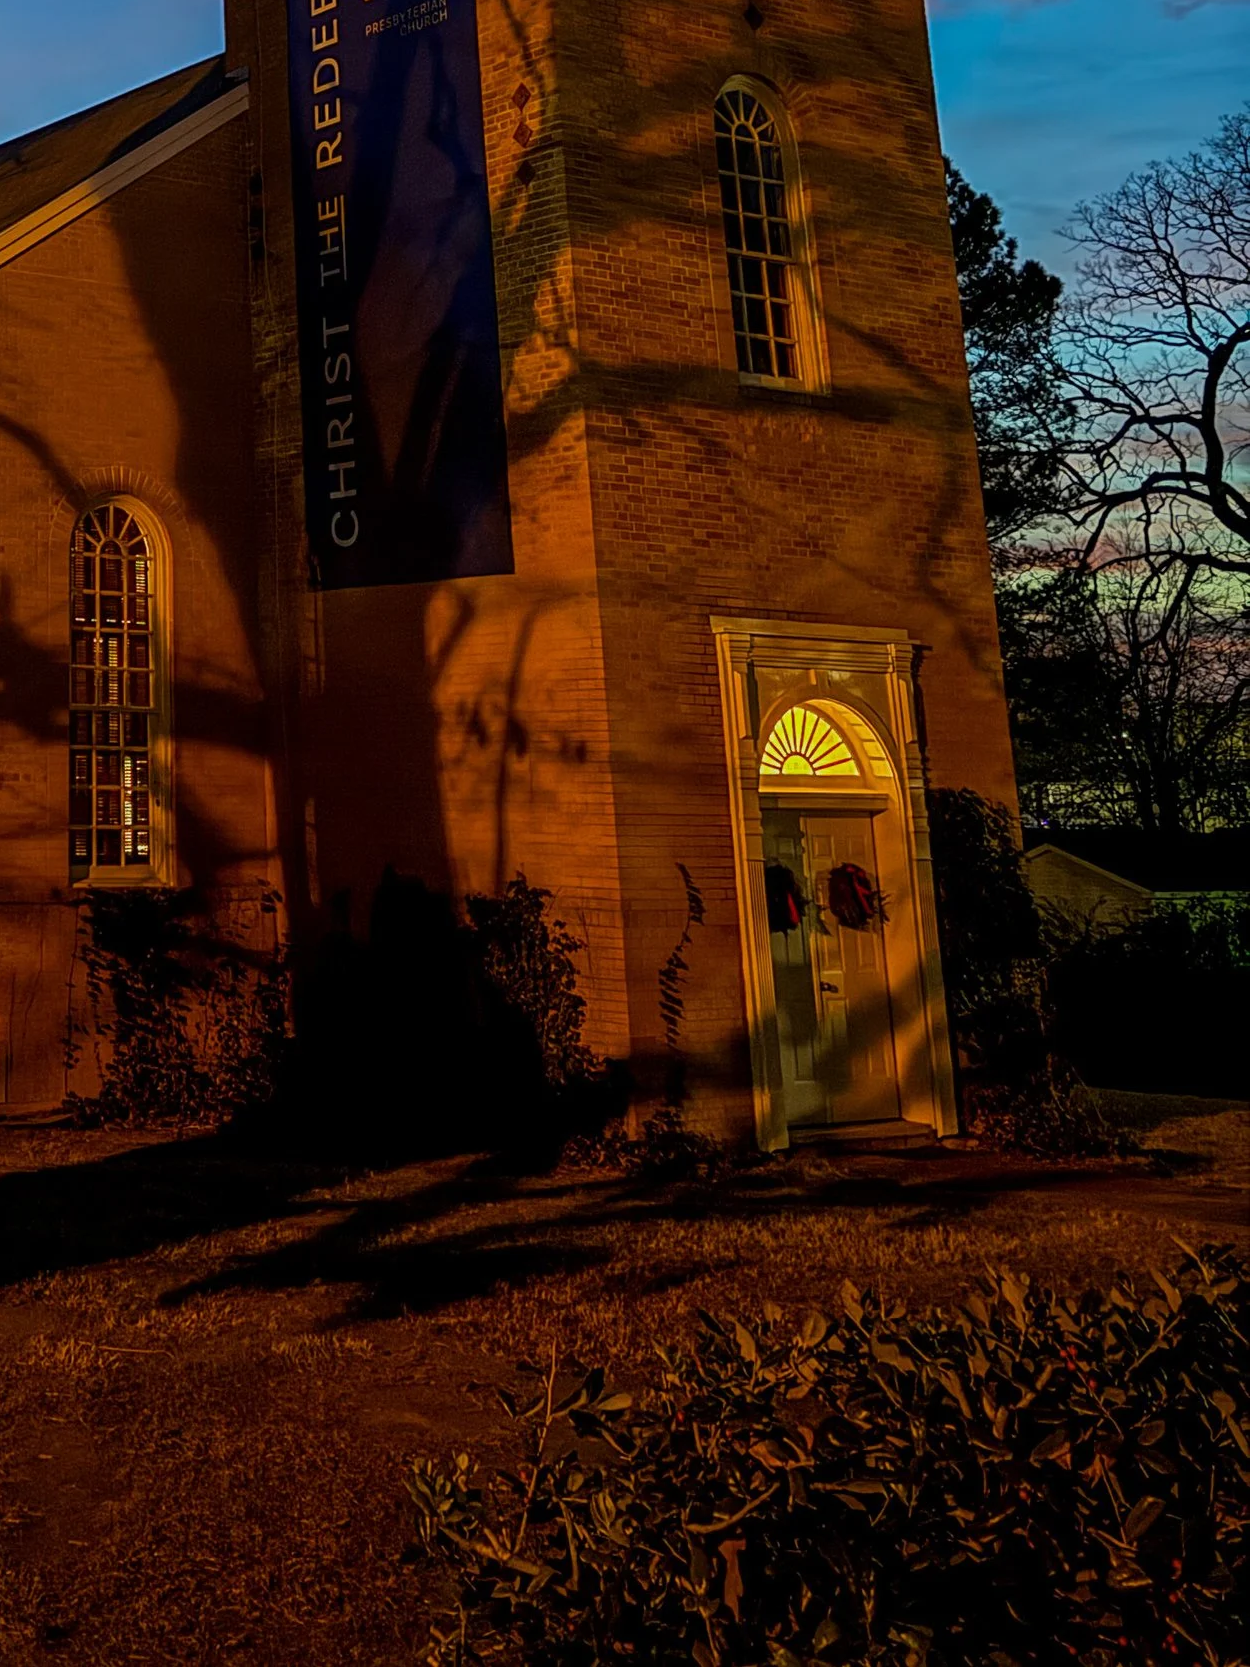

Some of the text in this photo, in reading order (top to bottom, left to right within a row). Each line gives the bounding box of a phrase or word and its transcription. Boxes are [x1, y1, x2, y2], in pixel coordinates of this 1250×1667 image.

[399, 8, 448, 36] CHURCH
[317, 195, 347, 288] THE
[323, 317, 360, 548] CHRIST
